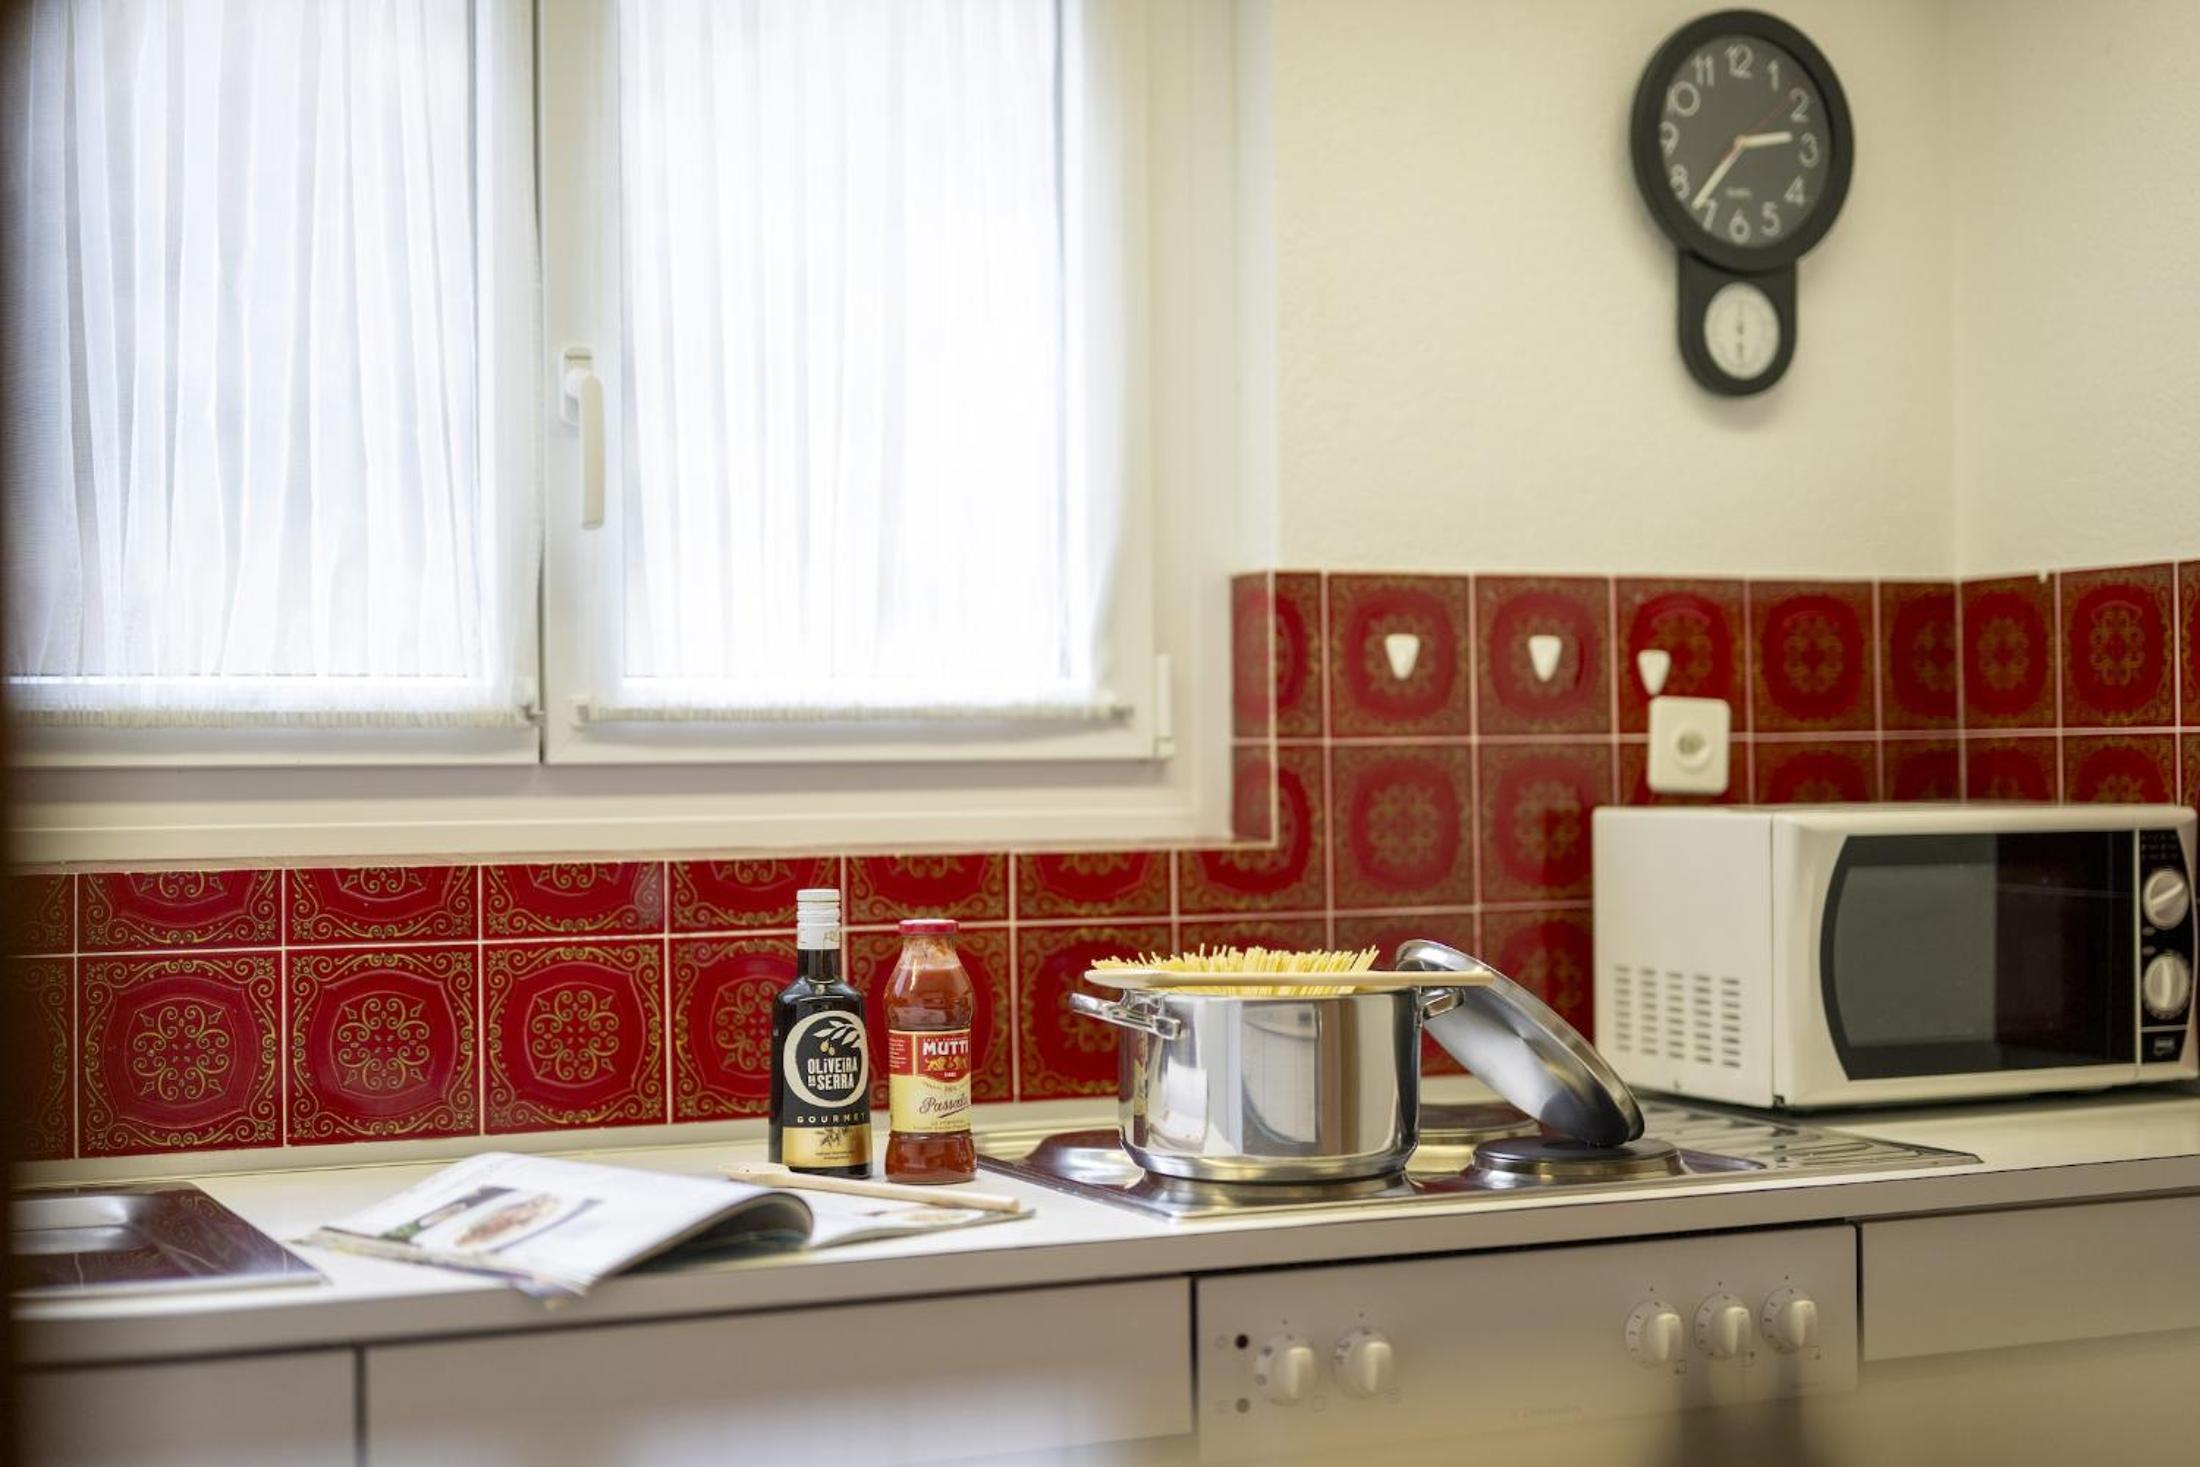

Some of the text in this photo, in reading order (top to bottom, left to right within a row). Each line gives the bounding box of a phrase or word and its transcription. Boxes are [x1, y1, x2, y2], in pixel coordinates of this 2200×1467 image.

[1691, 55, 1715, 87] 11
[1725, 44, 1753, 79] 12
[1766, 60, 1780, 91] 1
[1789, 87, 1809, 123] 2
[1660, 121, 1680, 156] 9
[1800, 132, 1819, 168] 3
[1670, 164, 1690, 200] 8
[1783, 175, 1805, 206] 4
[1701, 199, 1718, 232] 7
[1728, 208, 1751, 244] 6
[1761, 202, 1782, 237] 5
[922, 1040, 969, 1056] MUTTI
[807, 1057, 858, 1074] OLiVEiRA
[816, 1074, 855, 1091] SERRA
[797, 1112, 865, 1124] GOURMET
